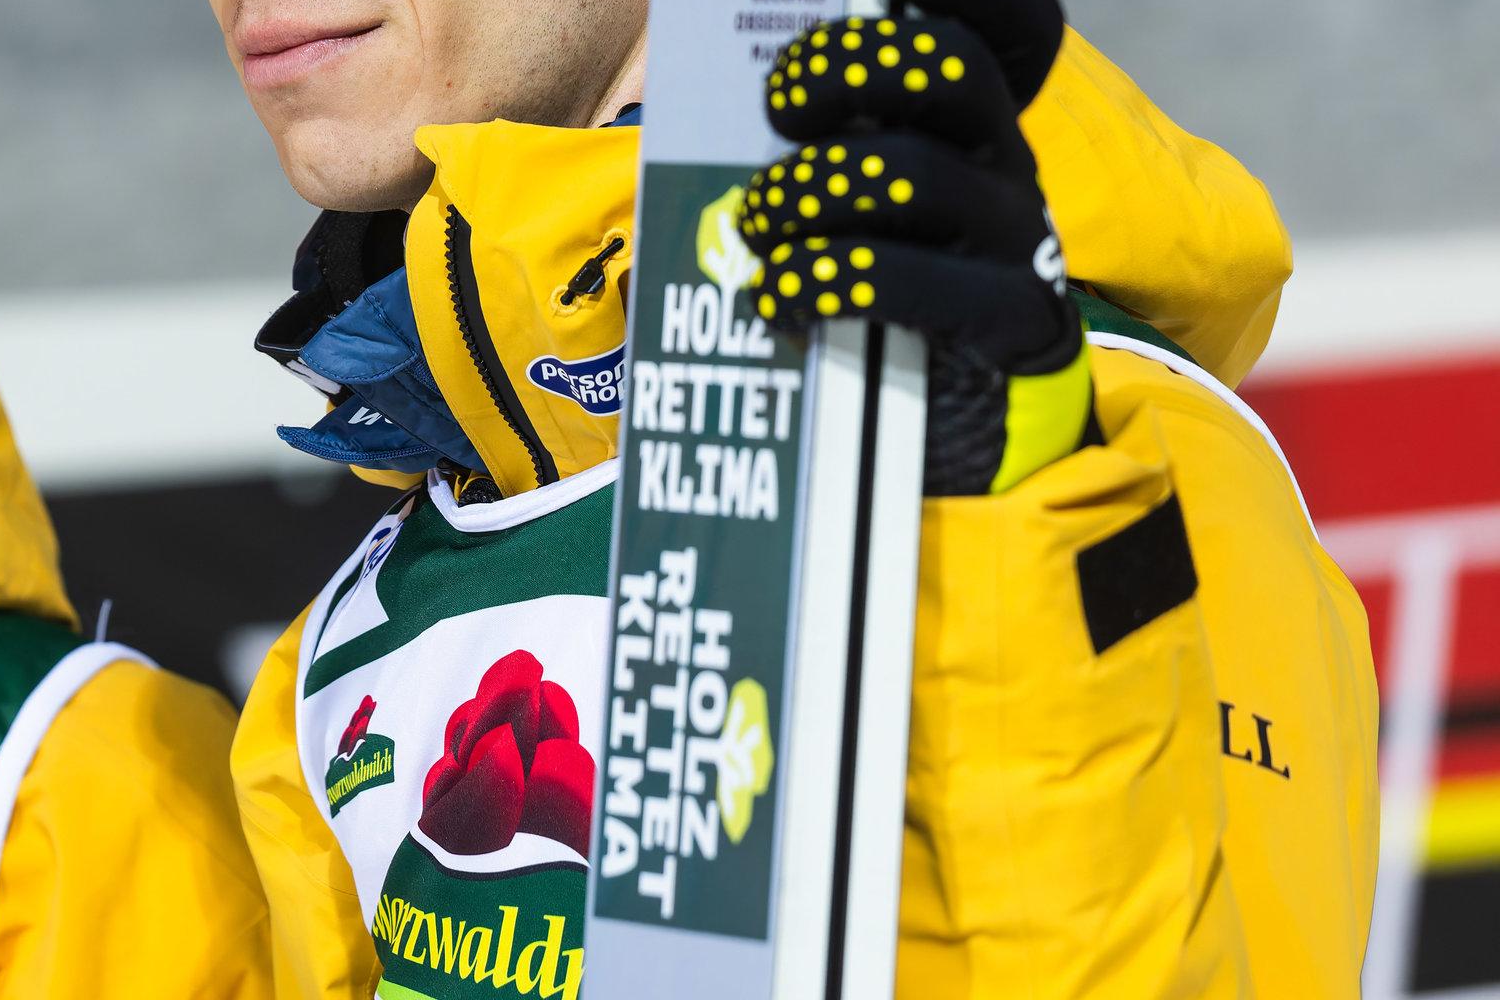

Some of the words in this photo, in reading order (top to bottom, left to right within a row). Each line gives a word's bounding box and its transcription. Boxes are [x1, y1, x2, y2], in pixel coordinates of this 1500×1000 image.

[631, 361, 802, 441] RETTET
[638, 439, 779, 522] KLIMA
[600, 570, 657, 879] KLIMA
[638, 546, 698, 920] RETTET
[680, 608, 733, 860] HOLZ
